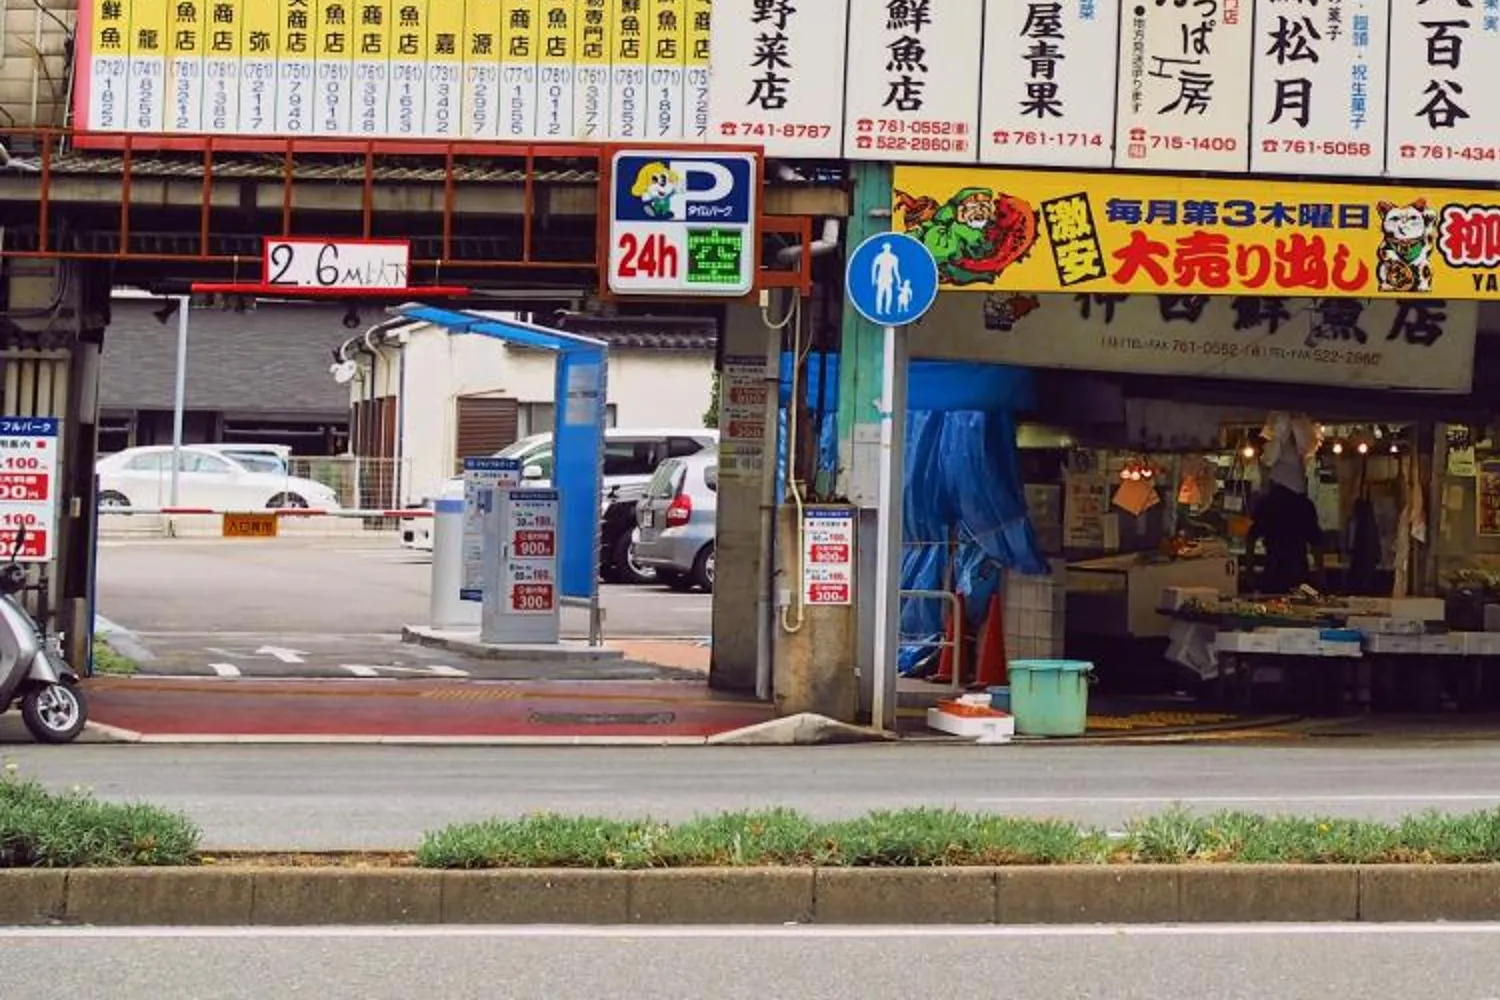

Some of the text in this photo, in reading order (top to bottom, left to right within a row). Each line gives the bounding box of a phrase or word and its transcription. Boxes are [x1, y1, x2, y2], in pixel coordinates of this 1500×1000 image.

[742, 121, 830, 140] 741-8787
[1013, 130, 1102, 148] 761-1714
[1151, 136, 1236, 151] 715-1400
[1105, 198, 1369, 230] 毎月第3木曜日
[618, 232, 678, 278] 24h
[1047, 195, 1102, 283] 激安
[1111, 230, 1369, 290] 大売り出し
